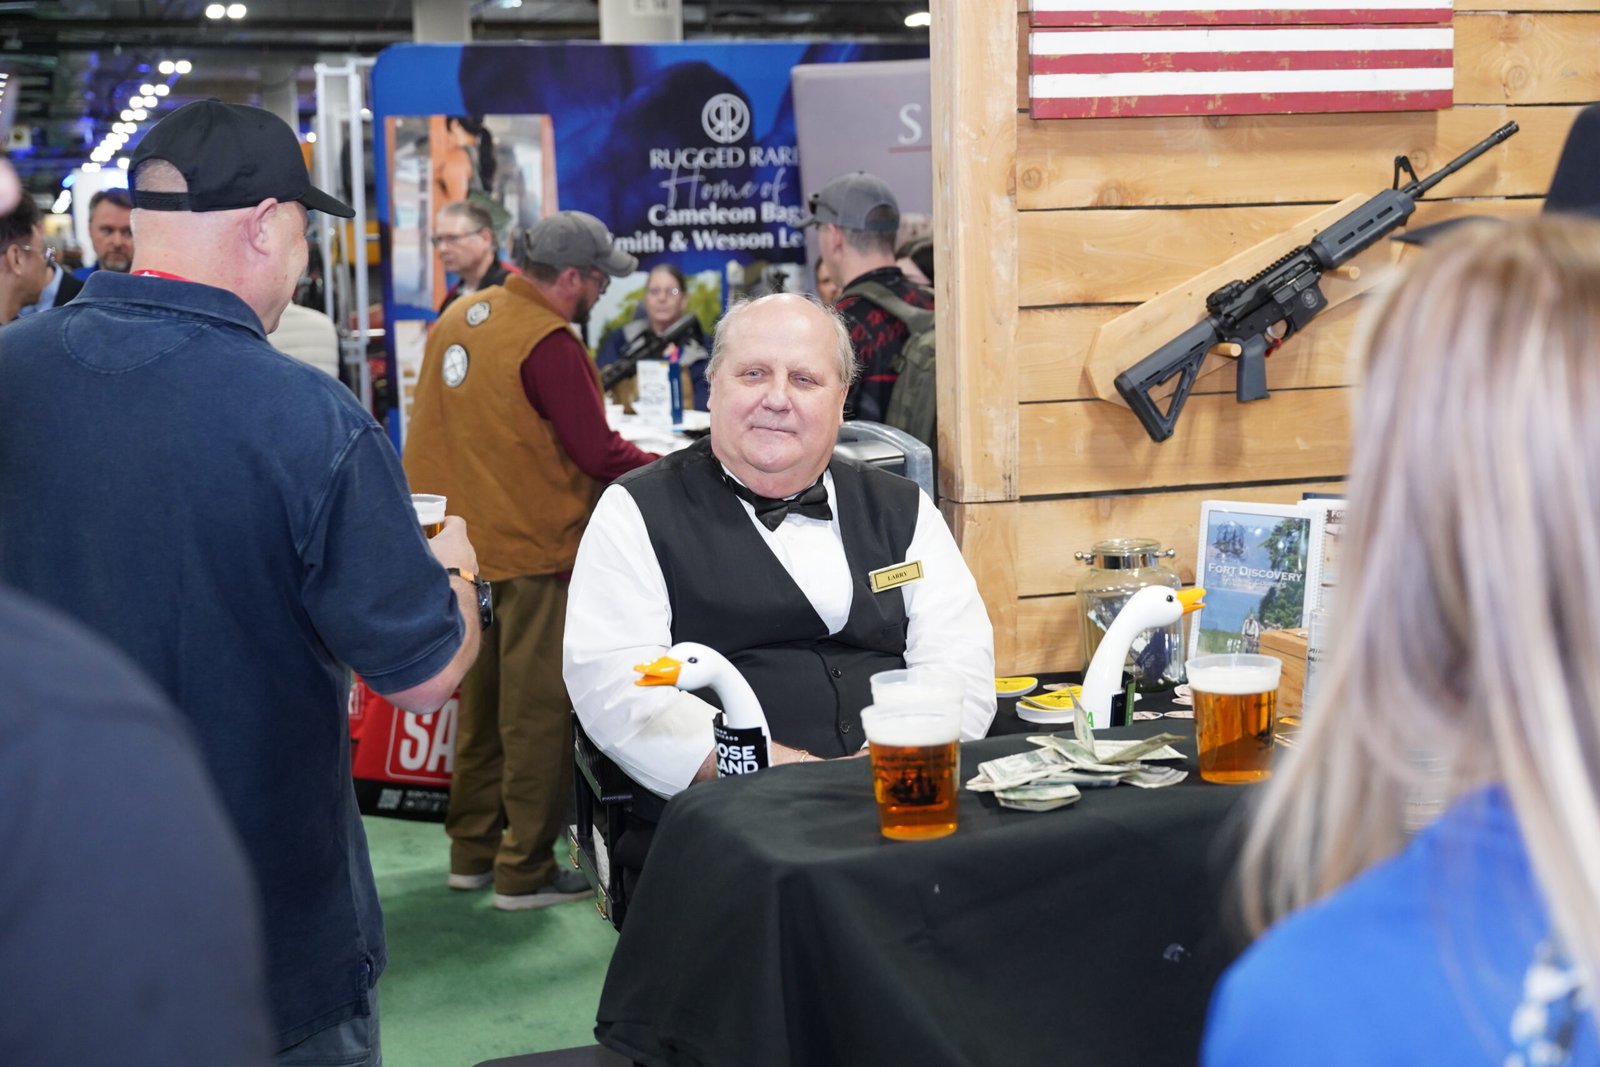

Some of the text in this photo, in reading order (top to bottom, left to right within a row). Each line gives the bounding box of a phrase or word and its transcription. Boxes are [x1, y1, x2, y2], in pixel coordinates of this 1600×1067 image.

[649, 147, 746, 170] RUGGED
[659, 160, 787, 209] Home of
[648, 201, 756, 227] Cameleon
[605, 229, 665, 253] mith
[669, 231, 689, 252] &
[691, 227, 774, 251] Wesson
[887, 571, 907, 581] LARRY
[1208, 562, 1303, 582] FORT DISCOVERY
